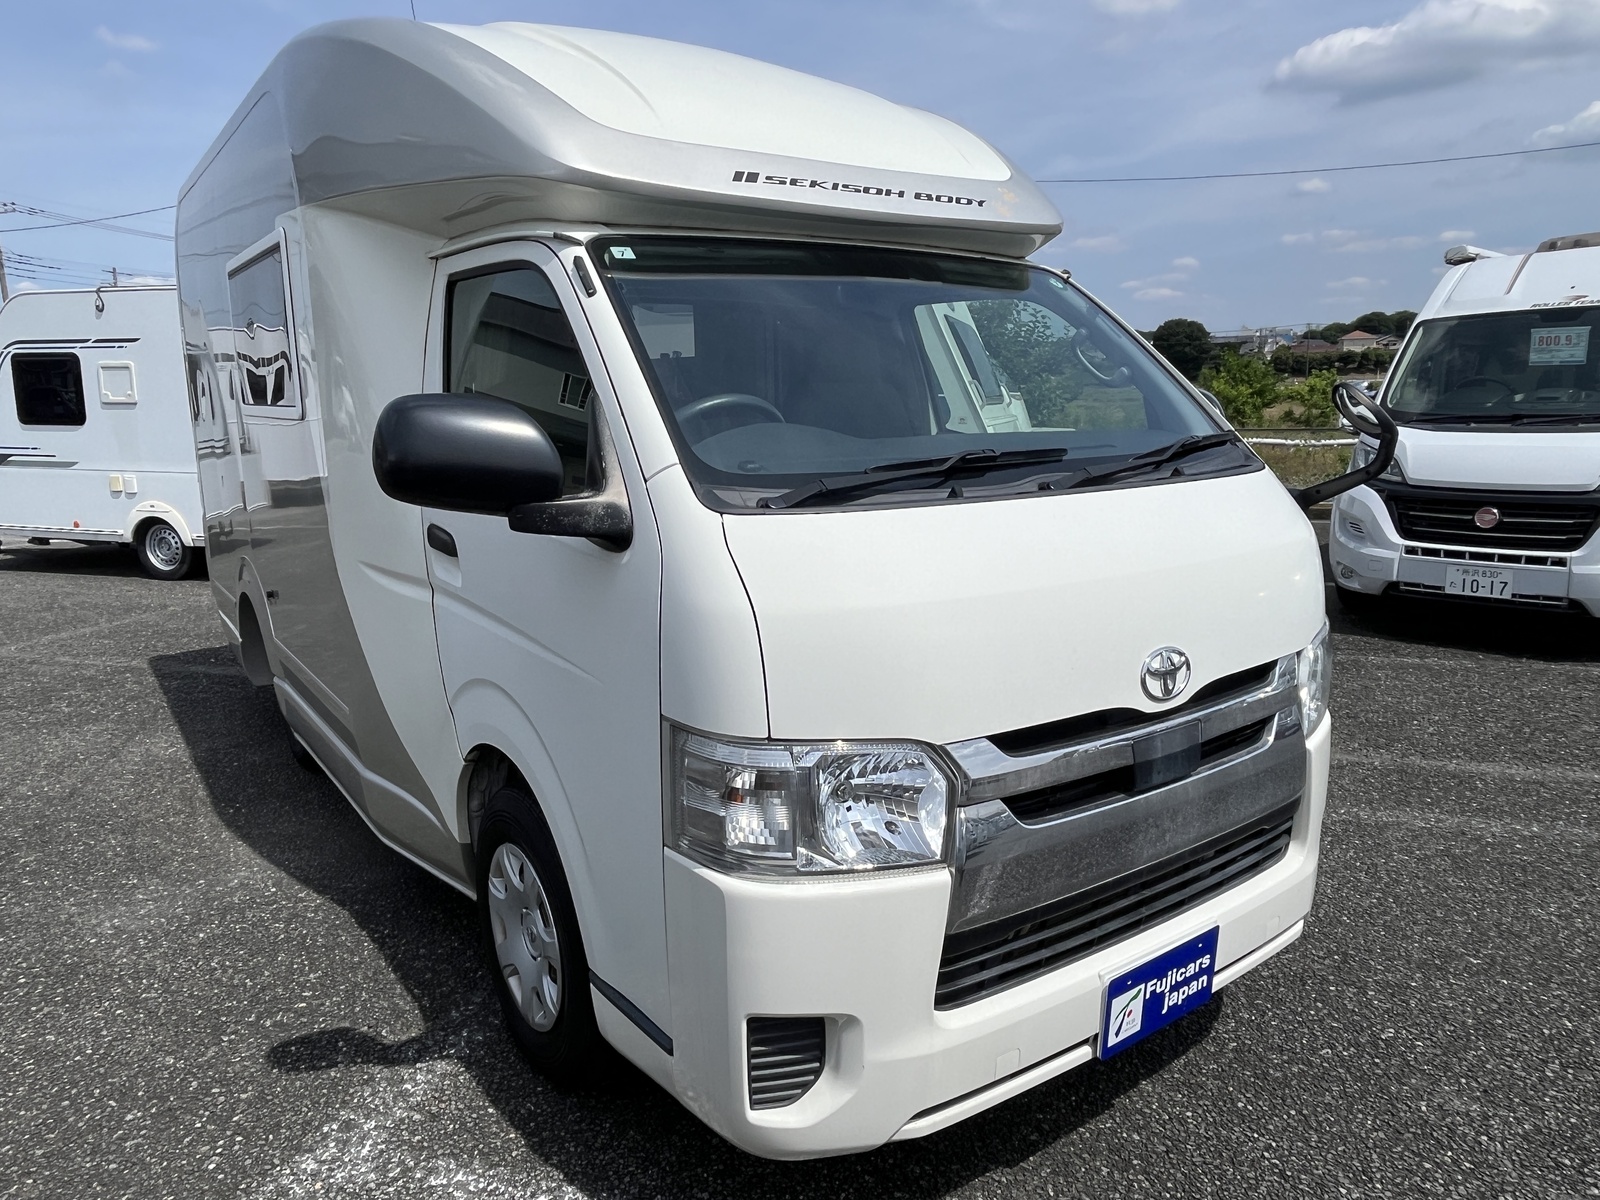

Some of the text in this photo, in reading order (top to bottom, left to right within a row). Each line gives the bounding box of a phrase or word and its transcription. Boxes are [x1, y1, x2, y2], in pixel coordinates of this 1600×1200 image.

[763, 175, 987, 207] SEKISOH BODY
[1462, 578, 1508, 596] 10-17
[1481, 570, 1499, 579] 830
[1145, 954, 1211, 999] Fujicars
